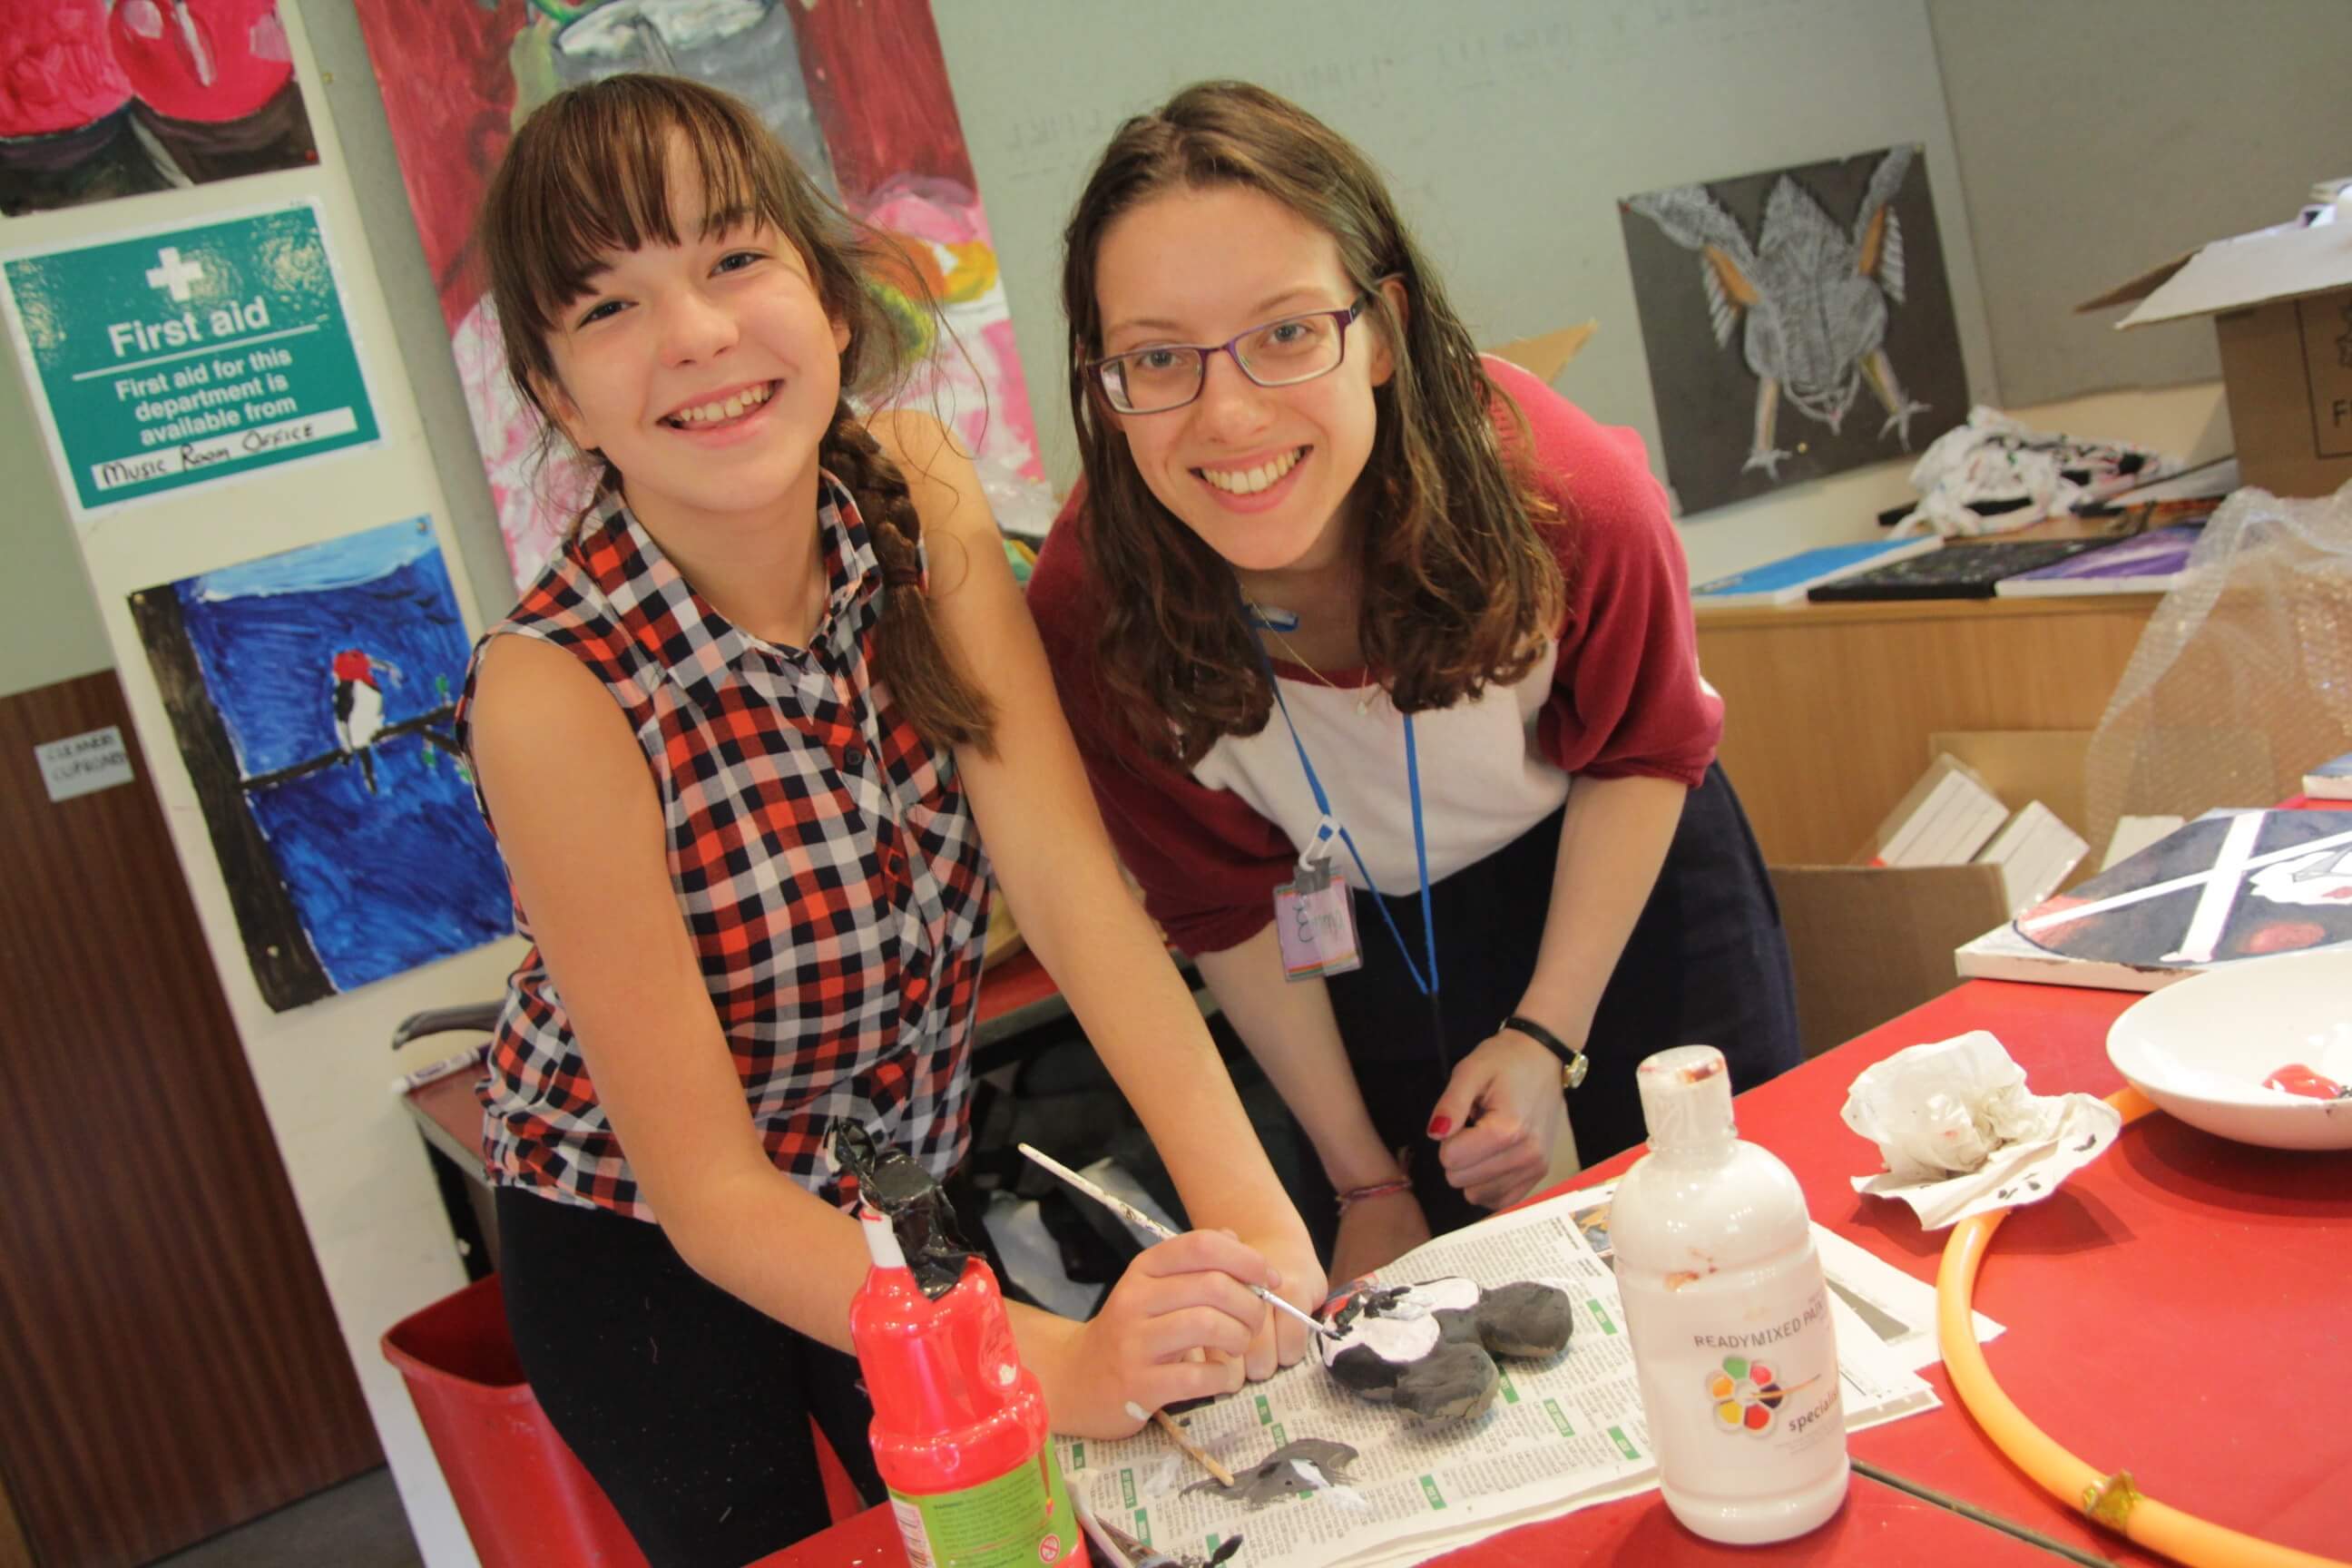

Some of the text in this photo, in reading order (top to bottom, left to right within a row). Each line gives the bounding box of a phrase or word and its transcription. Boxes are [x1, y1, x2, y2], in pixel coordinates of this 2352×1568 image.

[108, 295, 270, 358] First aid
[114, 348, 293, 401] First aid for this
[135, 372, 290, 422] department is
[140, 397, 298, 446] available from
[1694, 1318, 1801, 1349] READYMIXED
